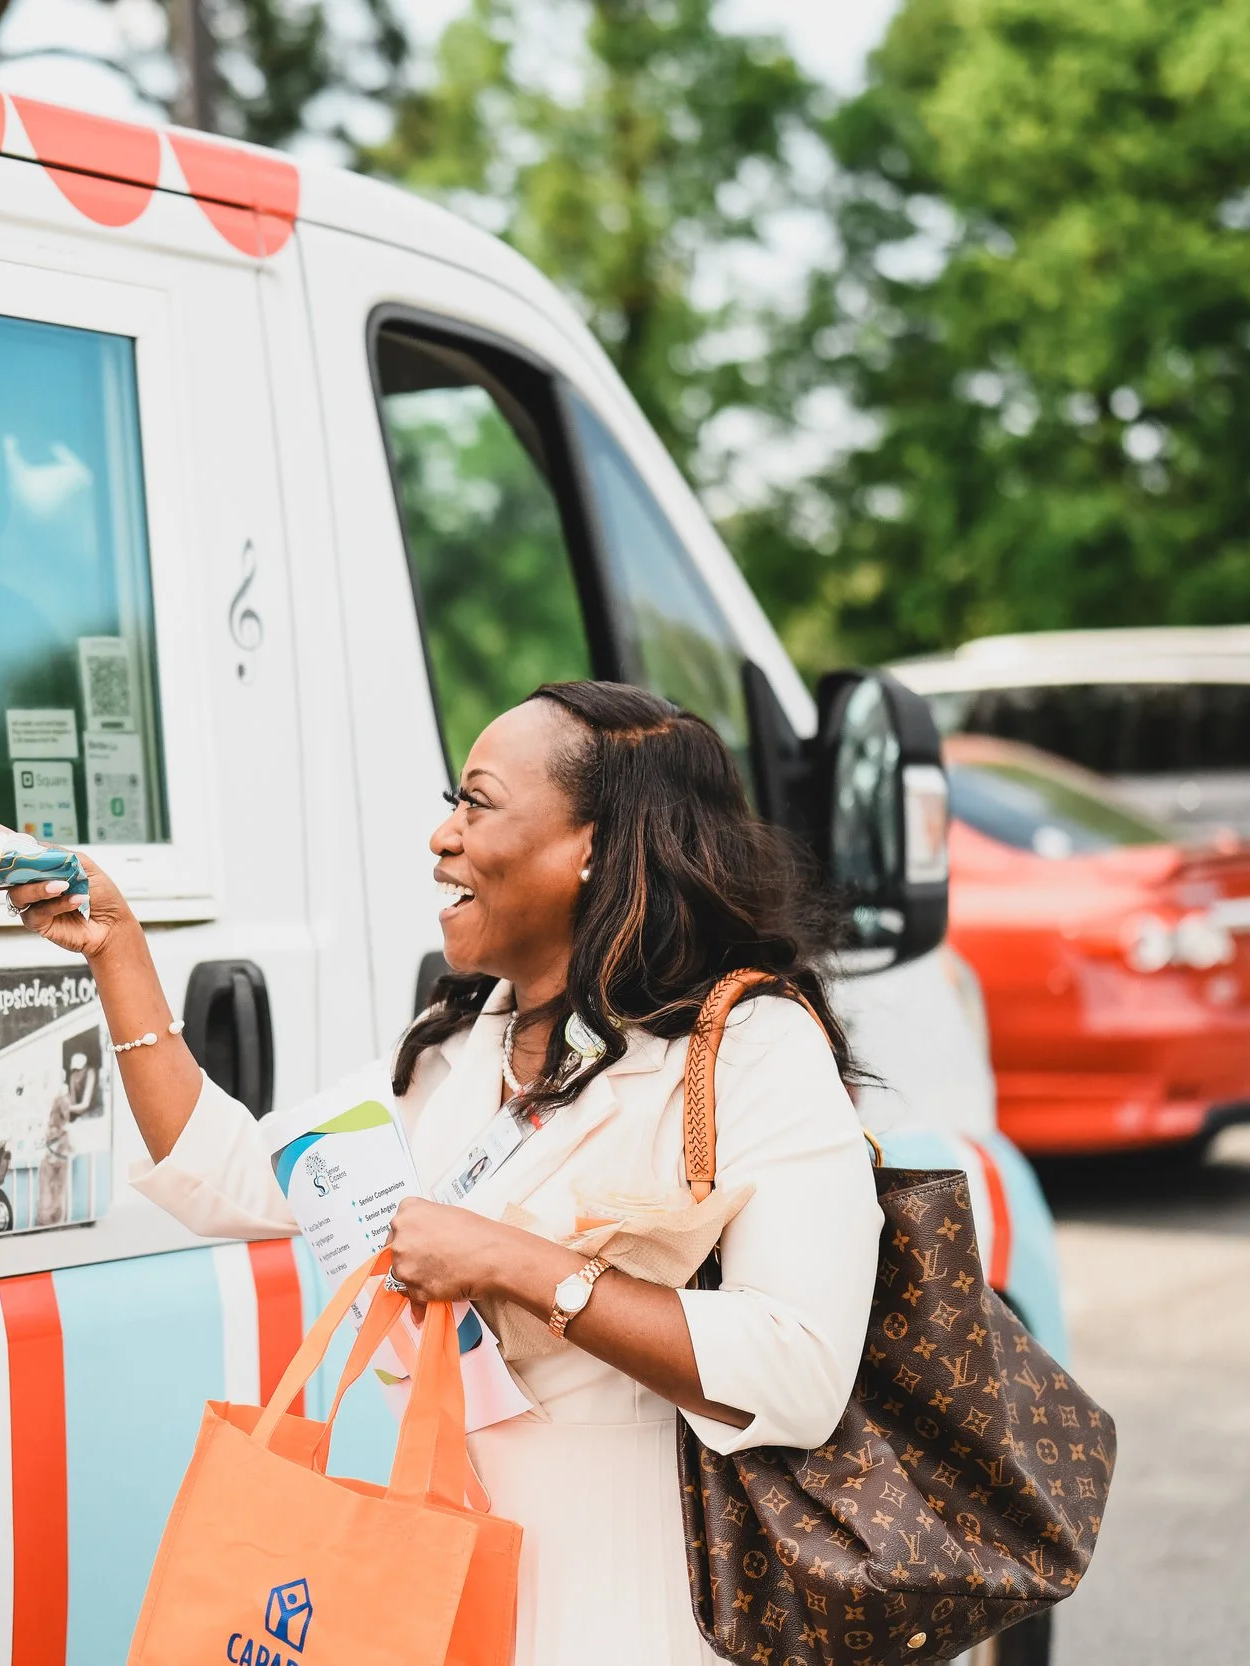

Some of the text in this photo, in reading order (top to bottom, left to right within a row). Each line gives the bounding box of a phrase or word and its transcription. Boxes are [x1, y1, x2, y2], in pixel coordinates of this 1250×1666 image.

[36, 774, 69, 789] Square
[325, 1165, 340, 1177] Senior
[328, 1170, 347, 1184] Citizens
[358, 1180, 406, 1207] Senior Companions
[364, 1202, 398, 1222] Senior Angels
[371, 1224, 390, 1237] Sterling
